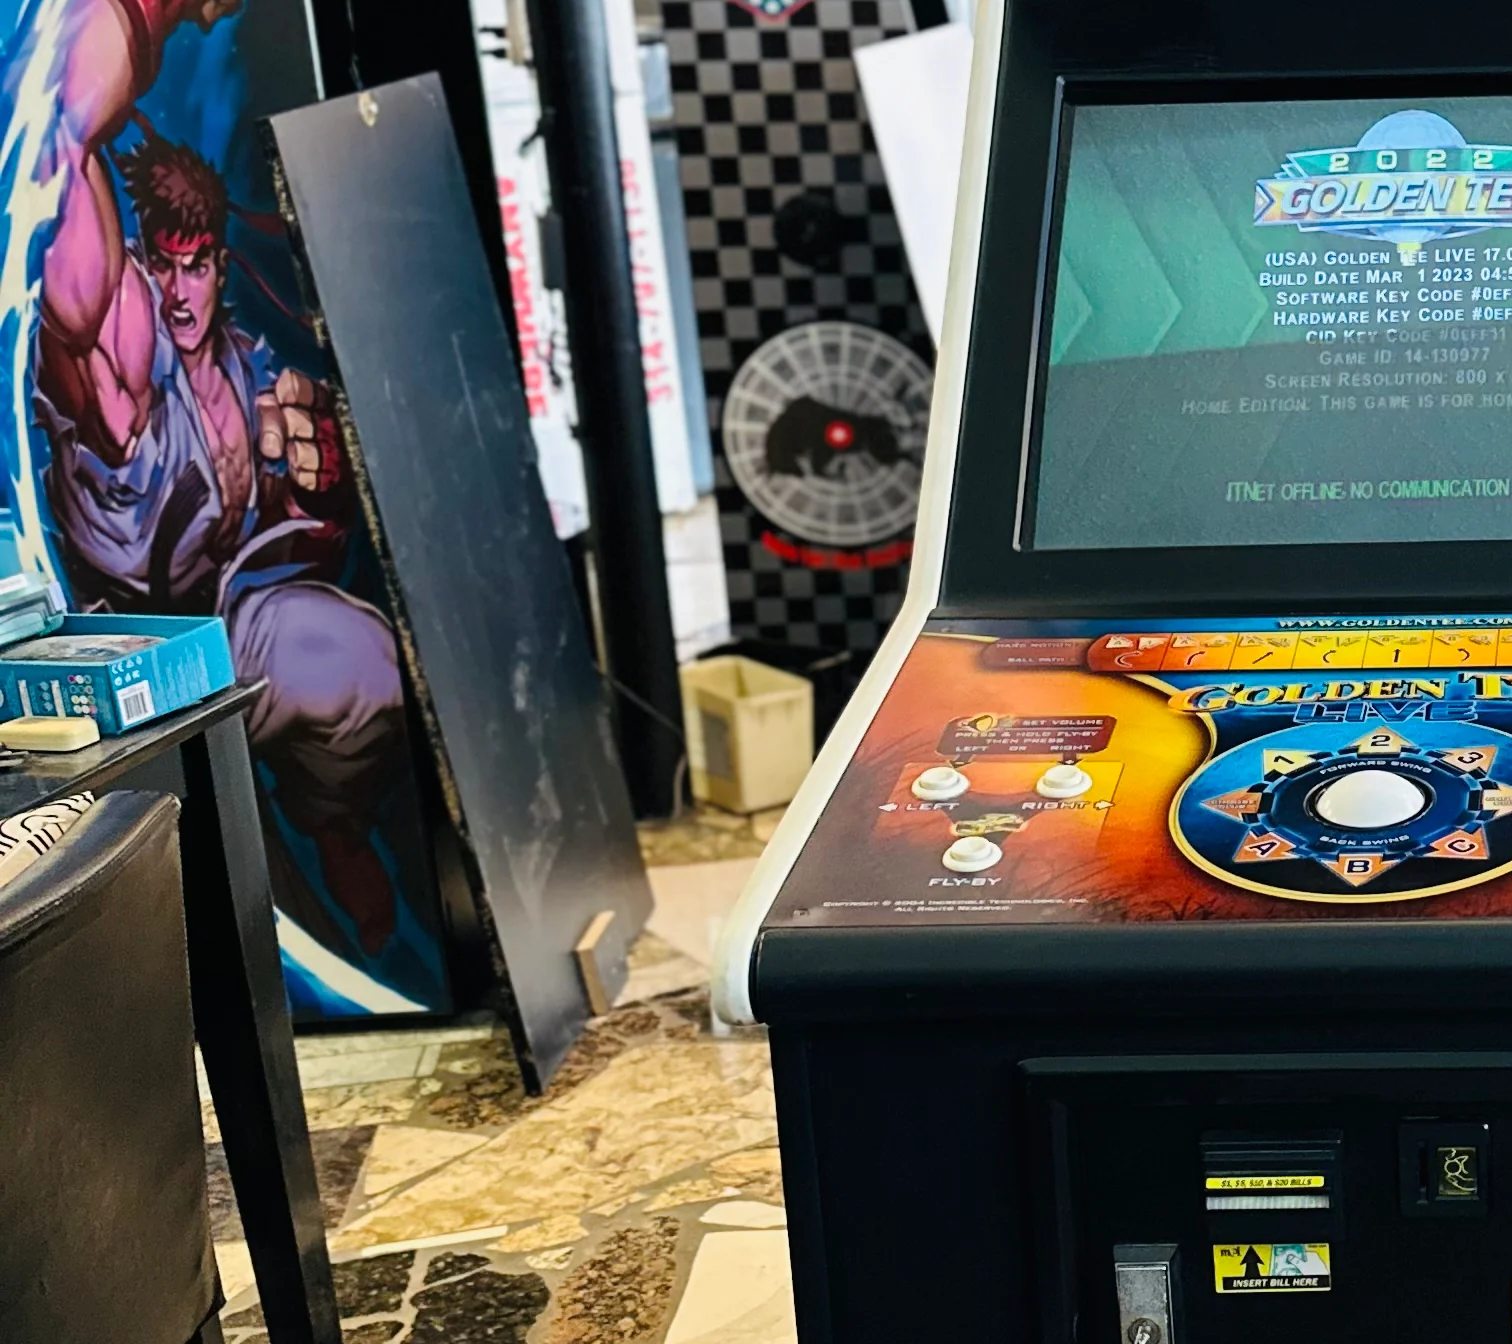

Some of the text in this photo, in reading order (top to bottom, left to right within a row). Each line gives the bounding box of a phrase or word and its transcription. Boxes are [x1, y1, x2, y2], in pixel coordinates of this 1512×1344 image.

[1280, 178, 1457, 215] GOLDEN
[1265, 252, 1316, 267] (USA)
[1324, 251, 1390, 265] GOLDEN
[1435, 248, 1475, 263] LIVE
[1260, 273, 1307, 286] BUILD
[1314, 271, 1359, 285] DATE
[1366, 270, 1402, 284] MAR
[1418, 269, 1425, 282] 1
[1432, 268, 1473, 282] 2023
[1277, 291, 1368, 305] SOFTWARE
[1376, 289, 1409, 303] KEY
[1418, 288, 1463, 302] CODE
[1274, 311, 1369, 325] HARDWARE
[1377, 308, 1410, 323] KEY
[1419, 308, 1464, 321] CODE
[1306, 330, 1336, 344] CID
[1456, 369, 1486, 384] 800
[1351, 481, 1372, 499] NO
[1378, 478, 1509, 499] COMMUNICATION
[1168, 678, 1449, 714] GOLDEN
[1293, 699, 1478, 723] LIVE
[1371, 734, 1392, 748] 2
[1458, 751, 1483, 767] 3
[905, 802, 961, 811] LEFT
[1022, 801, 1090, 810] RIGHT
[1247, 840, 1279, 856] A
[1447, 840, 1471, 853] C
[1346, 859, 1369, 874] B
[929, 877, 1002, 887] FLY-BY
[1233, 1278, 1318, 1287] INSERT BILL HERE
